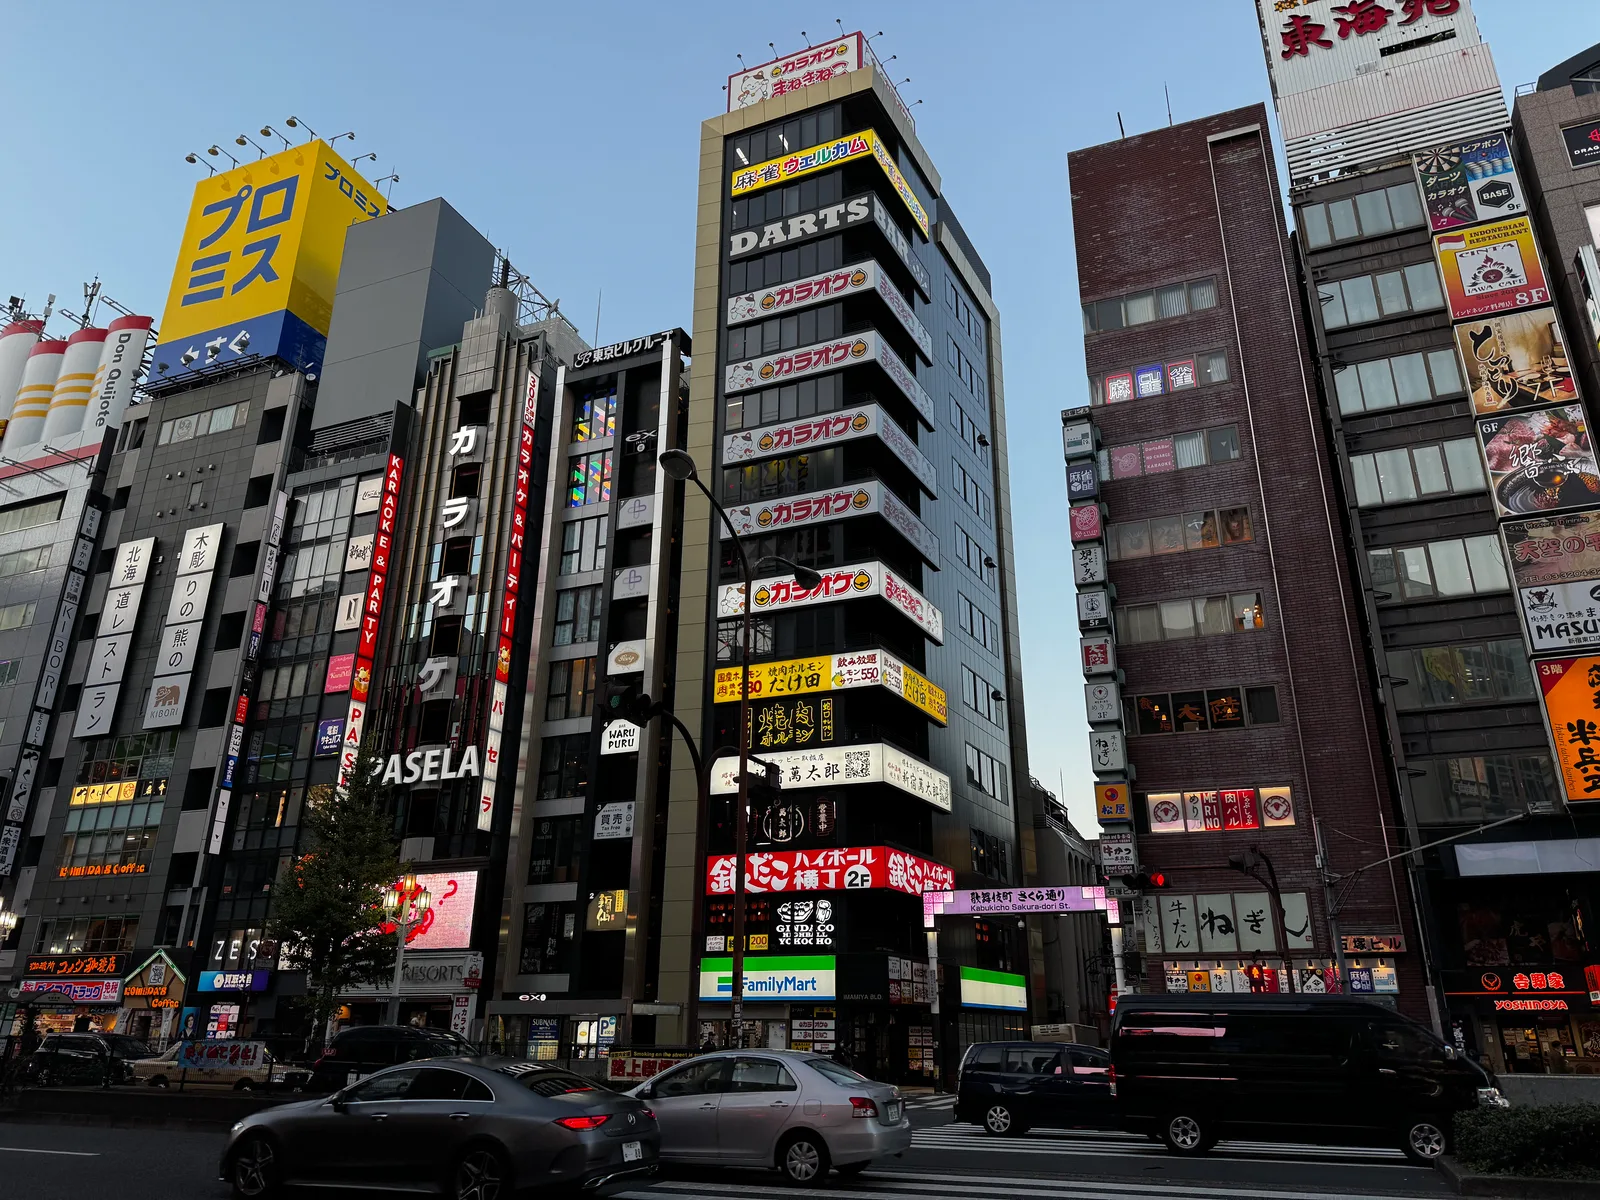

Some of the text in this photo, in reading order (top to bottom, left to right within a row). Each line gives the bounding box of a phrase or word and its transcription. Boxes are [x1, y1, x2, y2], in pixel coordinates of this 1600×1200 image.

[782, 46, 837, 74] カラオケ
[1461, 138, 1502, 153] ビアポン
[733, 163, 780, 190] 麻雀
[1425, 171, 1462, 188] ダーツ
[1427, 185, 1468, 201] カラオケ
[1482, 188, 1509, 200] BASE
[198, 173, 300, 251] プロ
[1507, 202, 1522, 211] 9F
[730, 196, 868, 257] DARTS
[874, 198, 909, 264] BAR
[1469, 221, 1526, 238] INDONESIAN
[1468, 228, 1529, 245] RESTAURANT
[180, 233, 282, 307] ミス
[775, 271, 851, 307] カラオケ
[1498, 278, 1526, 288] CAFE
[1515, 287, 1546, 306] 8F
[1454, 300, 1513, 317] インドネシア料理店
[593, 330, 674, 363] 東京ビルグループ
[775, 342, 851, 377] カラオケ
[95, 333, 132, 427] Don Quijote
[1526, 377, 1565, 400] 7F
[774, 415, 852, 448] カラオケ
[1482, 422, 1499, 433] 6F
[772, 491, 853, 526] カラオケ
[364, 456, 401, 644] KARAOKE & PARTY
[419, 425, 478, 692] カラオケ
[168, 532, 209, 667] 木彫りの熊の
[1536, 618, 1600, 639] MASU
[86, 546, 141, 730] 北海道レストラン
[43, 606, 72, 704] KIBORI
[837, 654, 877, 668] 飲み放題
[717, 670, 762, 683] 国産ホモン
[768, 661, 825, 677] 焼肉ホルモン
[840, 668, 860, 678] レモン
[861, 667, 879, 680] 550
[1541, 664, 1563, 676] 3階
[769, 673, 822, 692] たけ田
[840, 677, 861, 686] サワー
[150, 707, 179, 719] KIBORI
[1097, 711, 1108, 719] 3F
[609, 728, 635, 739] WARU
[608, 738, 634, 749] PURU
[1095, 738, 1109, 766] ねぎし
[482, 701, 504, 812] パセラ
[1101, 804, 1126, 815] 松屋
[1225, 793, 1239, 827] 肉バル
[1241, 792, 1253, 825] しゃぶしゃぶ
[793, 848, 877, 867] ハイボール
[1103, 845, 1131, 856] 牛かつ
[710, 853, 790, 893] 銀だこ
[793, 869, 840, 890] 横丁
[847, 871, 870, 887] 2F
[888, 852, 923, 896] 銀だこ
[970, 889, 1065, 904] 歌舞伎町 さくら通り
[970, 904, 1010, 912] Kabukicho
[1012, 903, 1057, 911] Sakura-dori
[1169, 900, 1190, 949] 牛たん
[1201, 907, 1309, 940] ねぎし
[751, 936, 767, 945] 200
[401, 965, 464, 982] RESORTS
[1167, 976, 1187, 984] 牛かつ
[1513, 972, 1565, 989] 吉野家
[103, 982, 119, 994] 免税
[124, 986, 167, 996] KOMEDA'S
[741, 976, 817, 993] FamilyMart
[151, 998, 179, 1008] Coffee
[532, 1018, 558, 1026] SUBNADE
[601, 1019, 609, 1034] P
